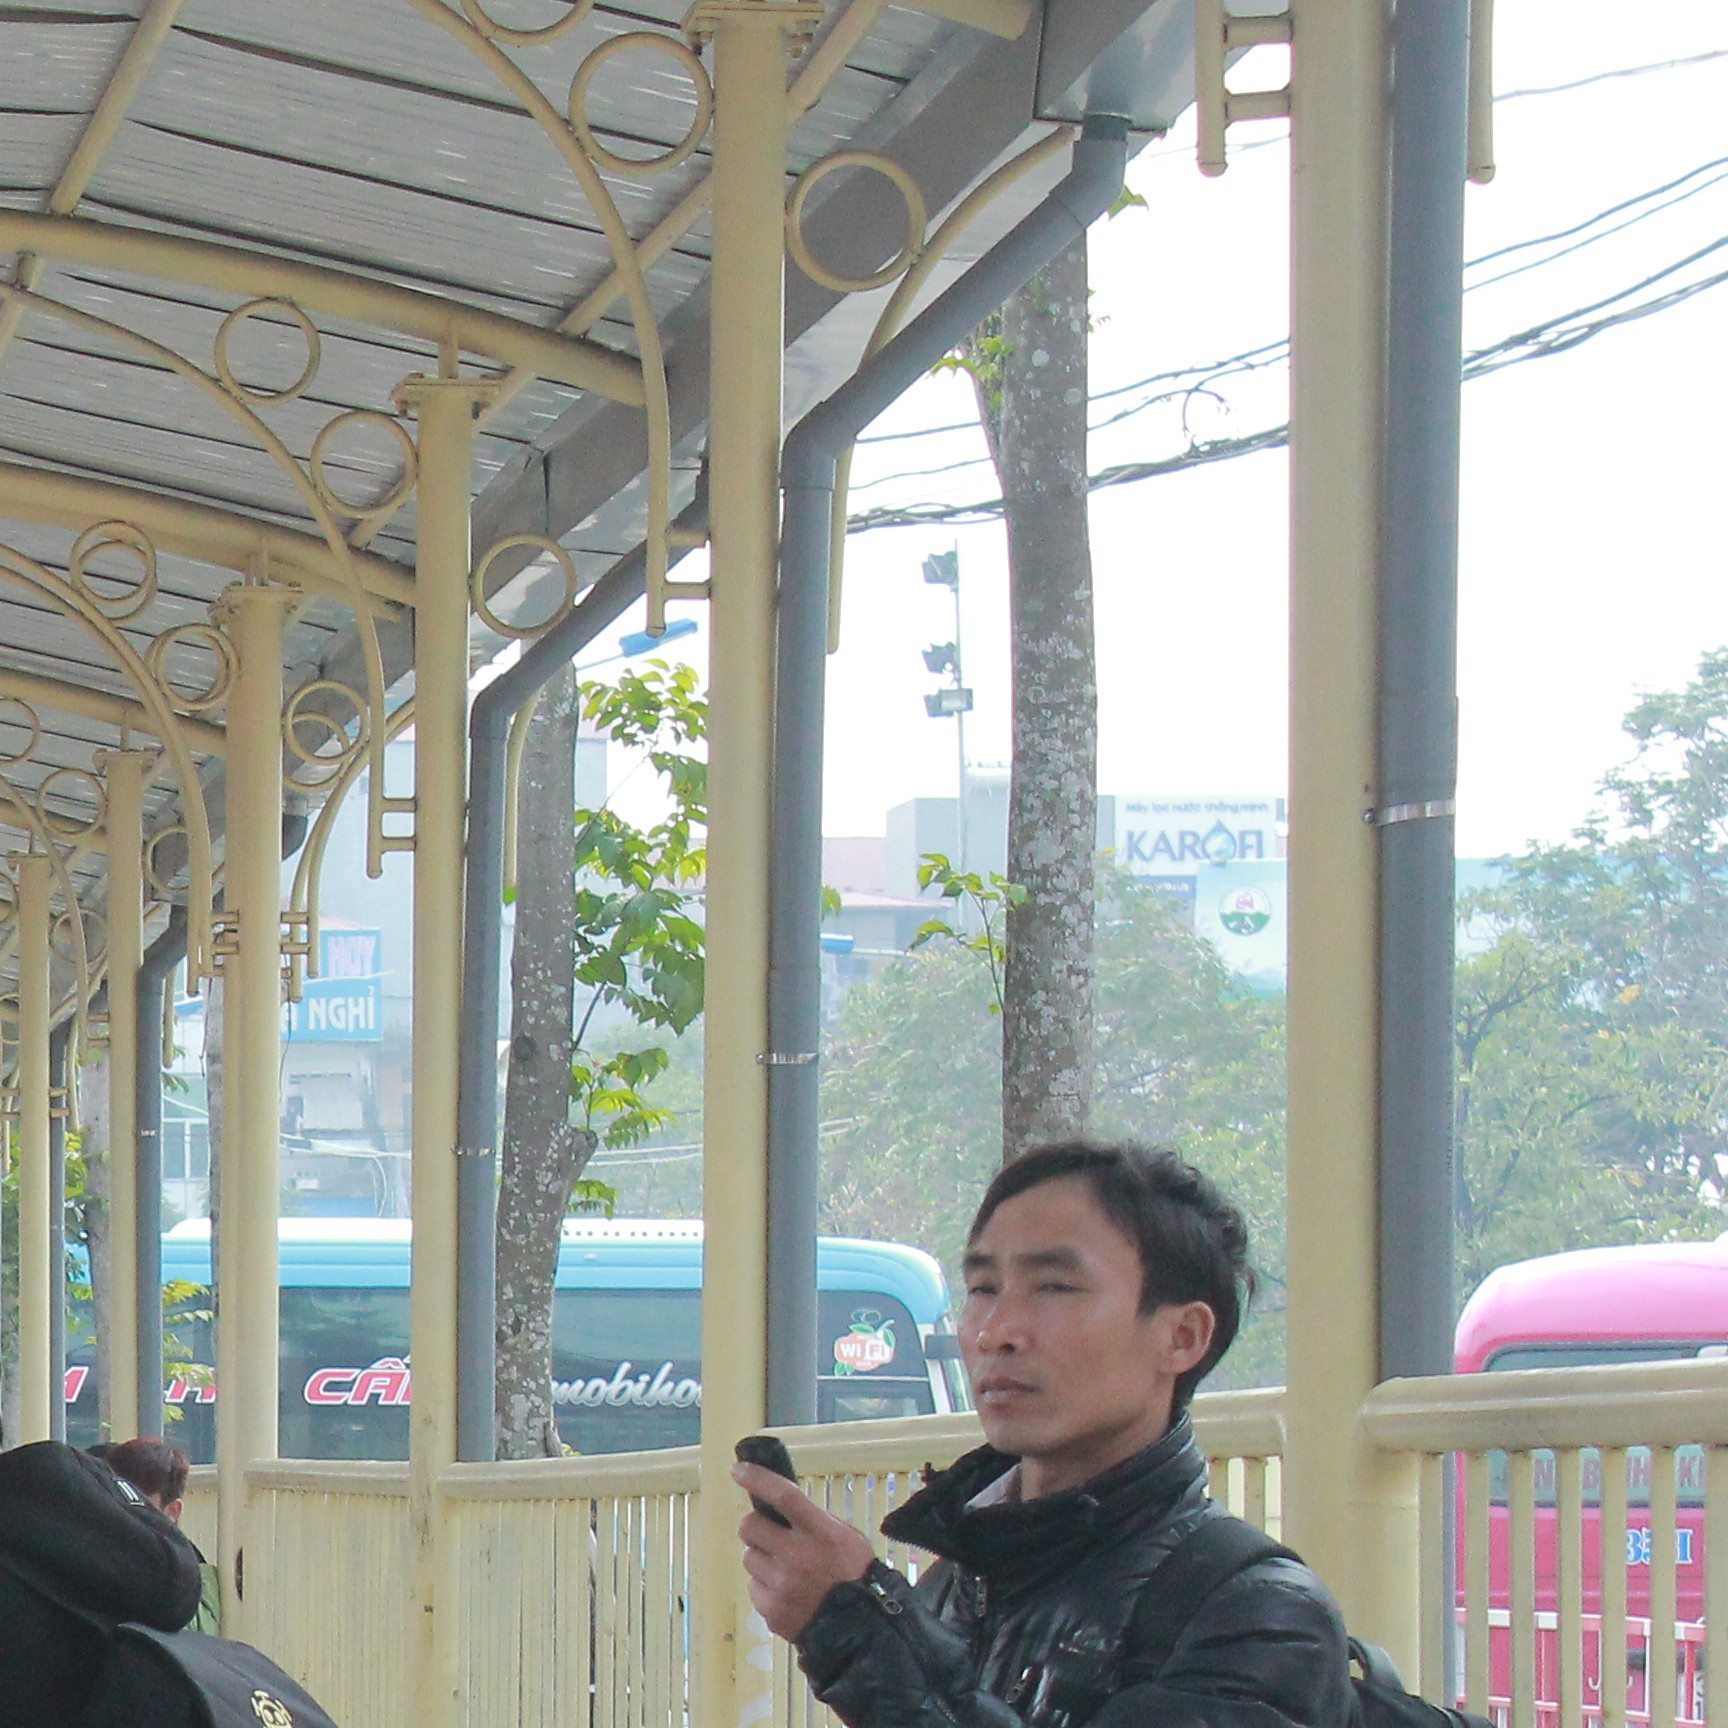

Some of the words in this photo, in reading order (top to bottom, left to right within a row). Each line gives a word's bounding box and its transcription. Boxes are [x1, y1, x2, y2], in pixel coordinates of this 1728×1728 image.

[1126, 819, 1264, 862] KAROFI
[308, 985, 375, 1032] NGHỈ
[304, 1357, 412, 1404] CẤ
